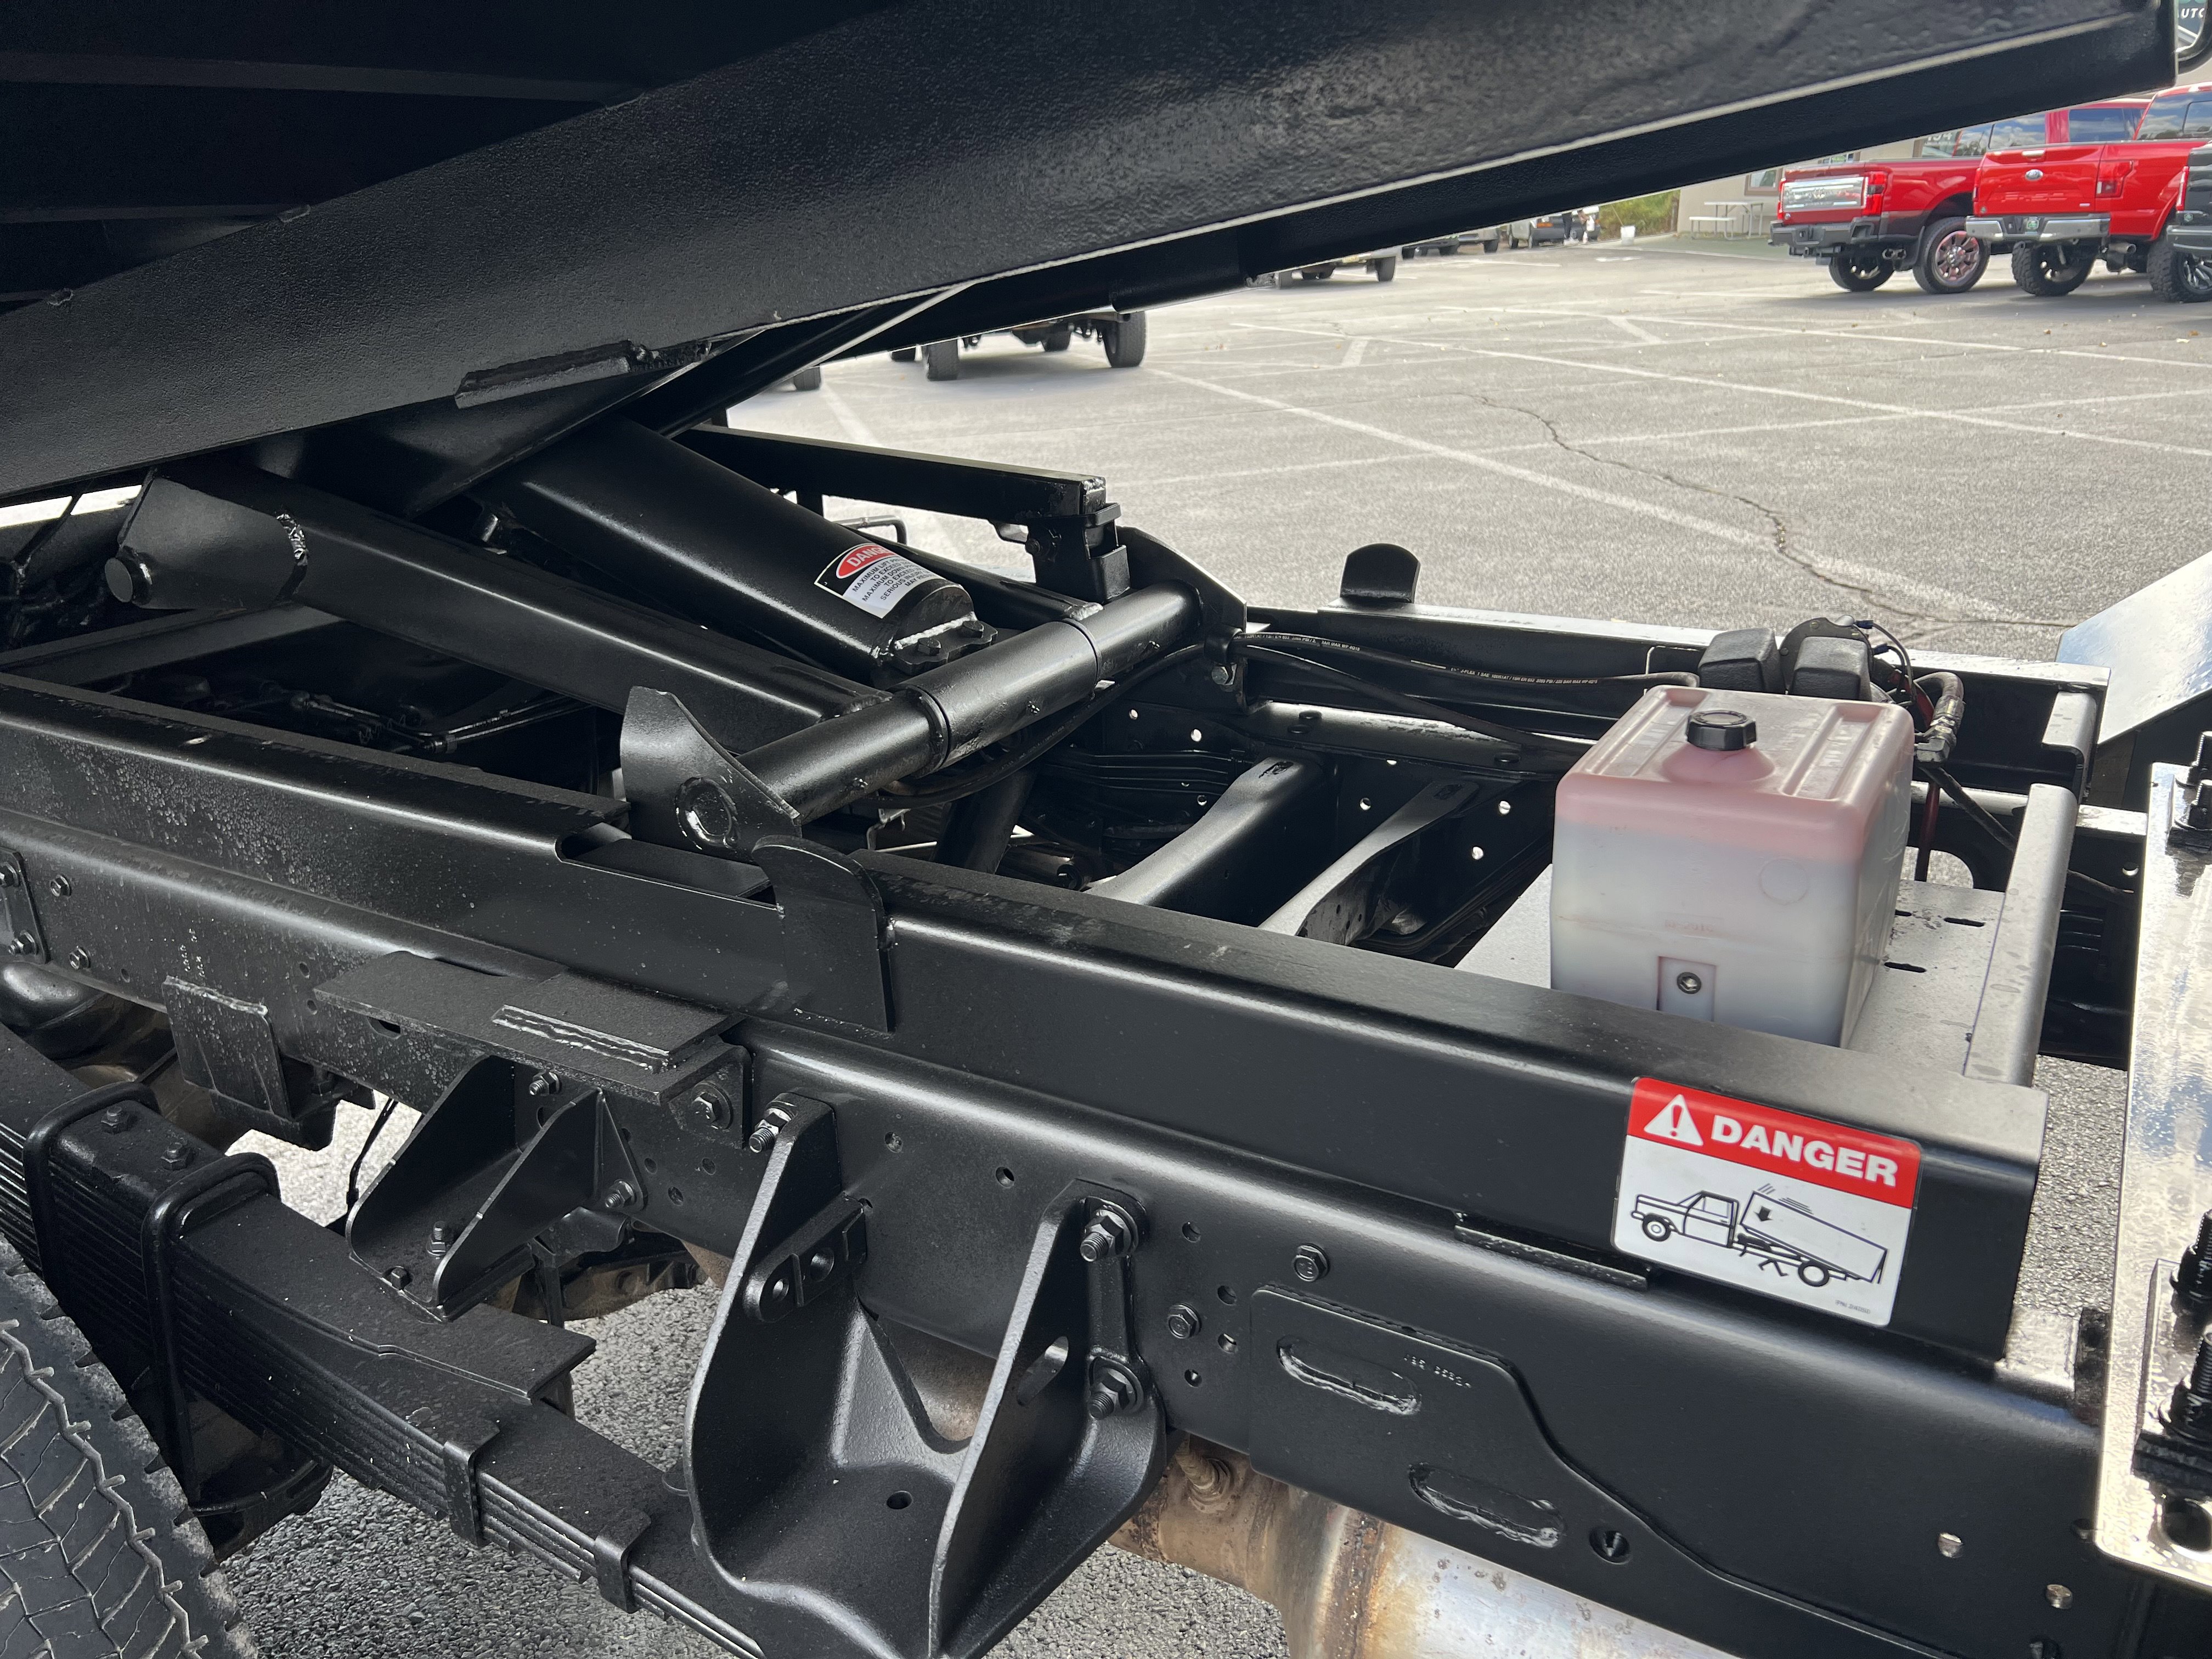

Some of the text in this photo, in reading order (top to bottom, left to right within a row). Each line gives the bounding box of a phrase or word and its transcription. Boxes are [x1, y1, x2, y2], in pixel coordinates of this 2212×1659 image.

[852, 567, 879, 592] MAXIMUM
[878, 562, 901, 575] EXCEED
[892, 568, 915, 580] EXCEED
[862, 566, 905, 601] MAXIMUM DOWN
[880, 578, 906, 601] SERIOUS
[904, 578, 918, 587] MAY
[1711, 1115, 1898, 1188] DANGER
